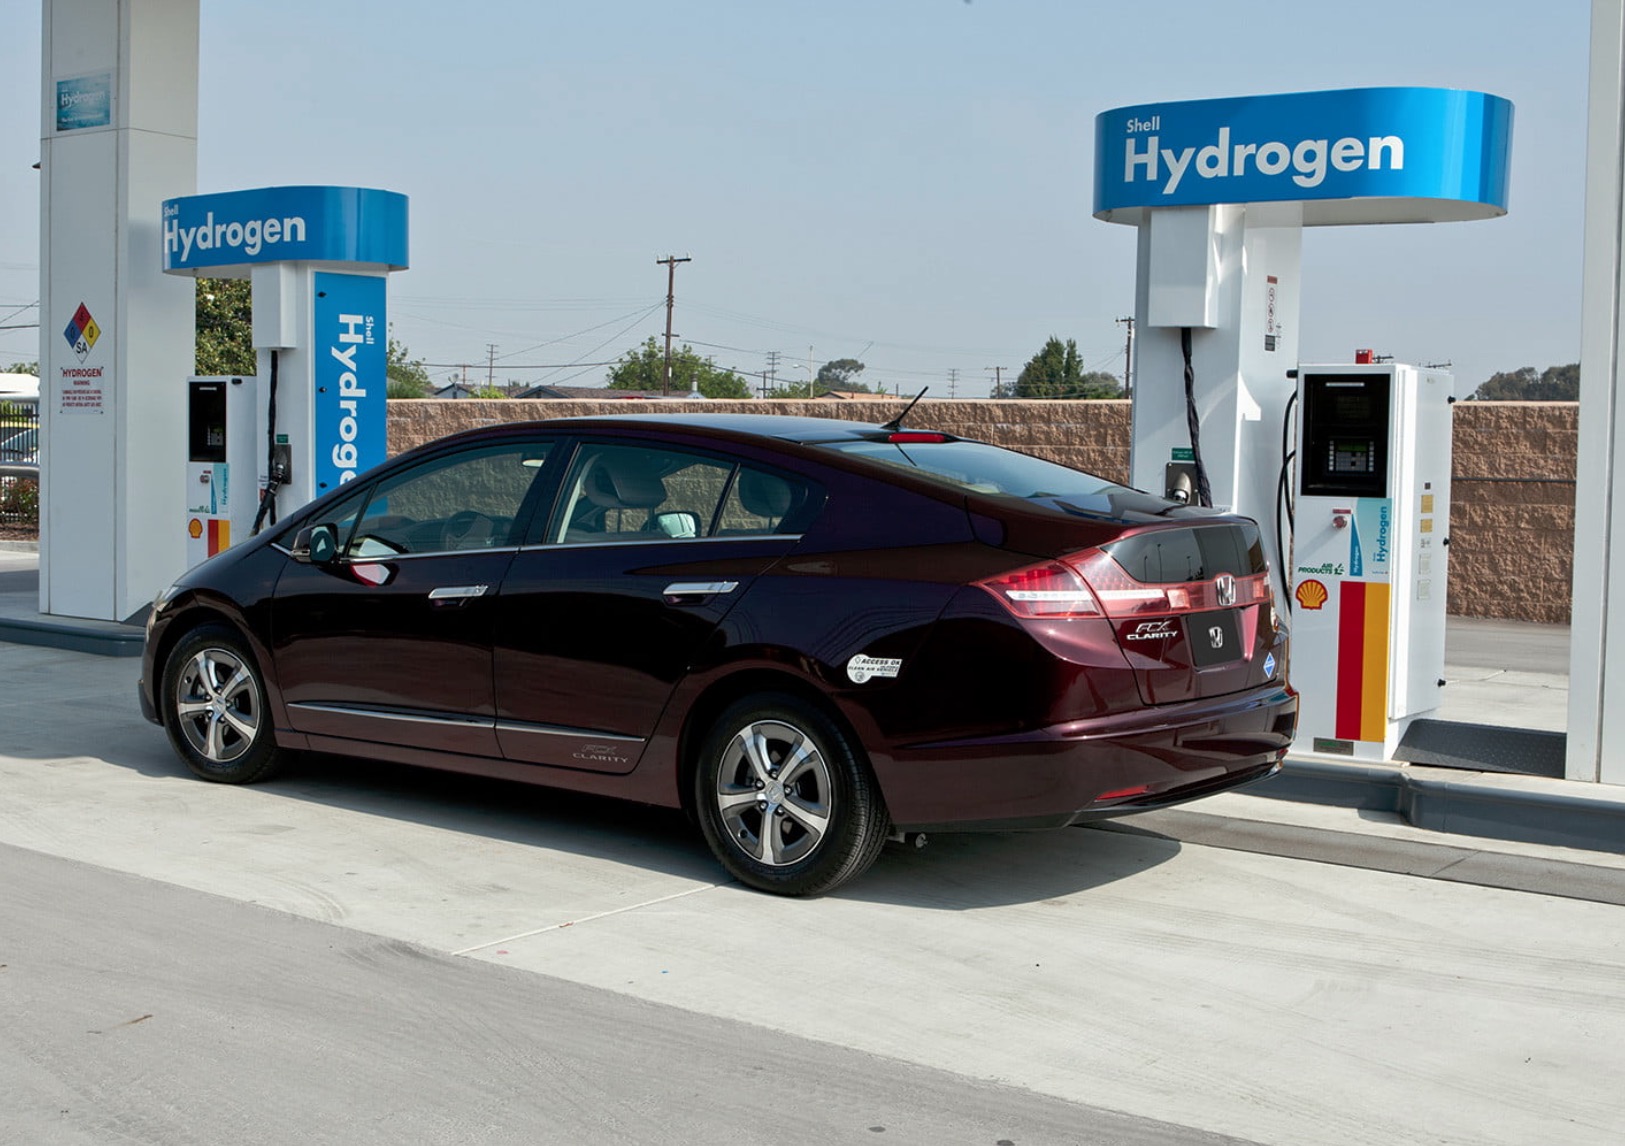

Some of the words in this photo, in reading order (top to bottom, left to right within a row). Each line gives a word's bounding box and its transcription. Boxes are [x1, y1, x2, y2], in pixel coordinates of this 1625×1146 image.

[1126, 115, 1160, 133] Shell
[1124, 127, 1405, 195] Hydrogen
[164, 204, 179, 217] Shell
[164, 211, 306, 262] Hydrogen
[365, 315, 375, 345] Shell
[76, 342, 88, 354] SA
[62, 369, 102, 378] HYDROGEN
[1376, 506, 1390, 562] Hydrogen
[1298, 566, 1333, 575] PRODUCTS
[1126, 630, 1178, 640] CLARITY
[572, 752, 628, 763] CLARITY
